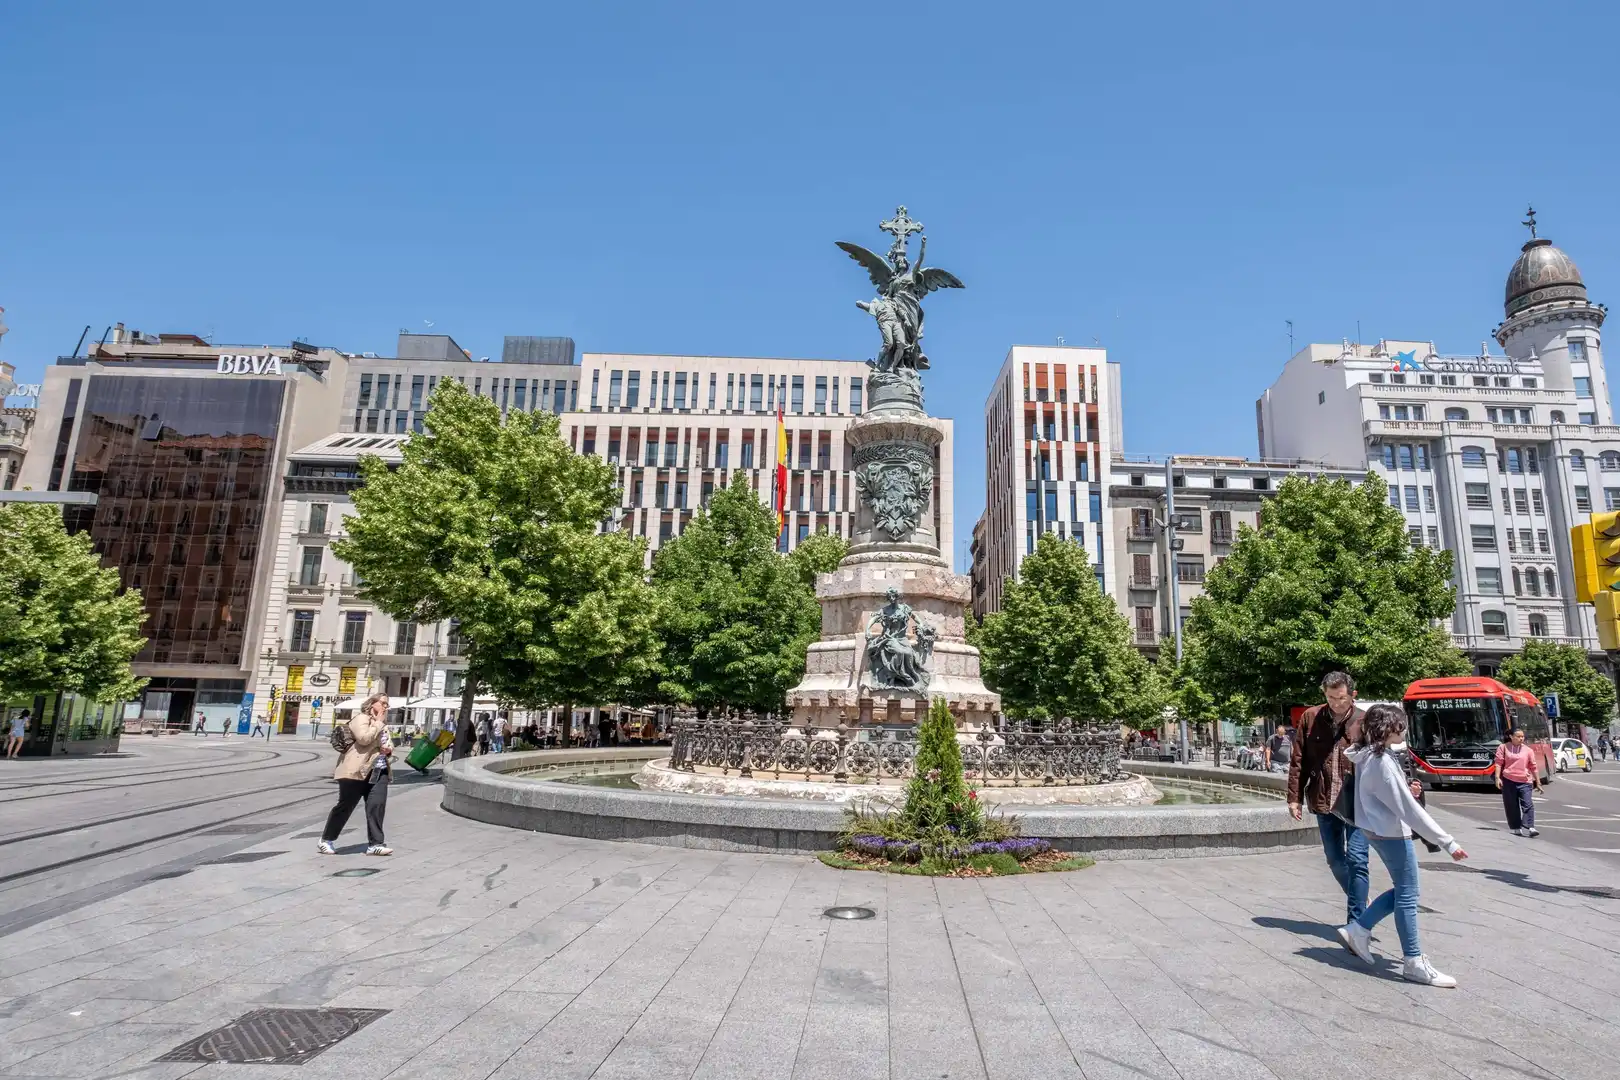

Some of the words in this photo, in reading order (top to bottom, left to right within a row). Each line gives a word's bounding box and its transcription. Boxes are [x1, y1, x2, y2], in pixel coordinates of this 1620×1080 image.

[217, 354, 281, 375] BBVA
[1423, 354, 1522, 374] CaixaBank
[283, 694, 312, 703] ESCOGE
[1546, 698, 1552, 708] P
[1416, 700, 1428, 709] 40
